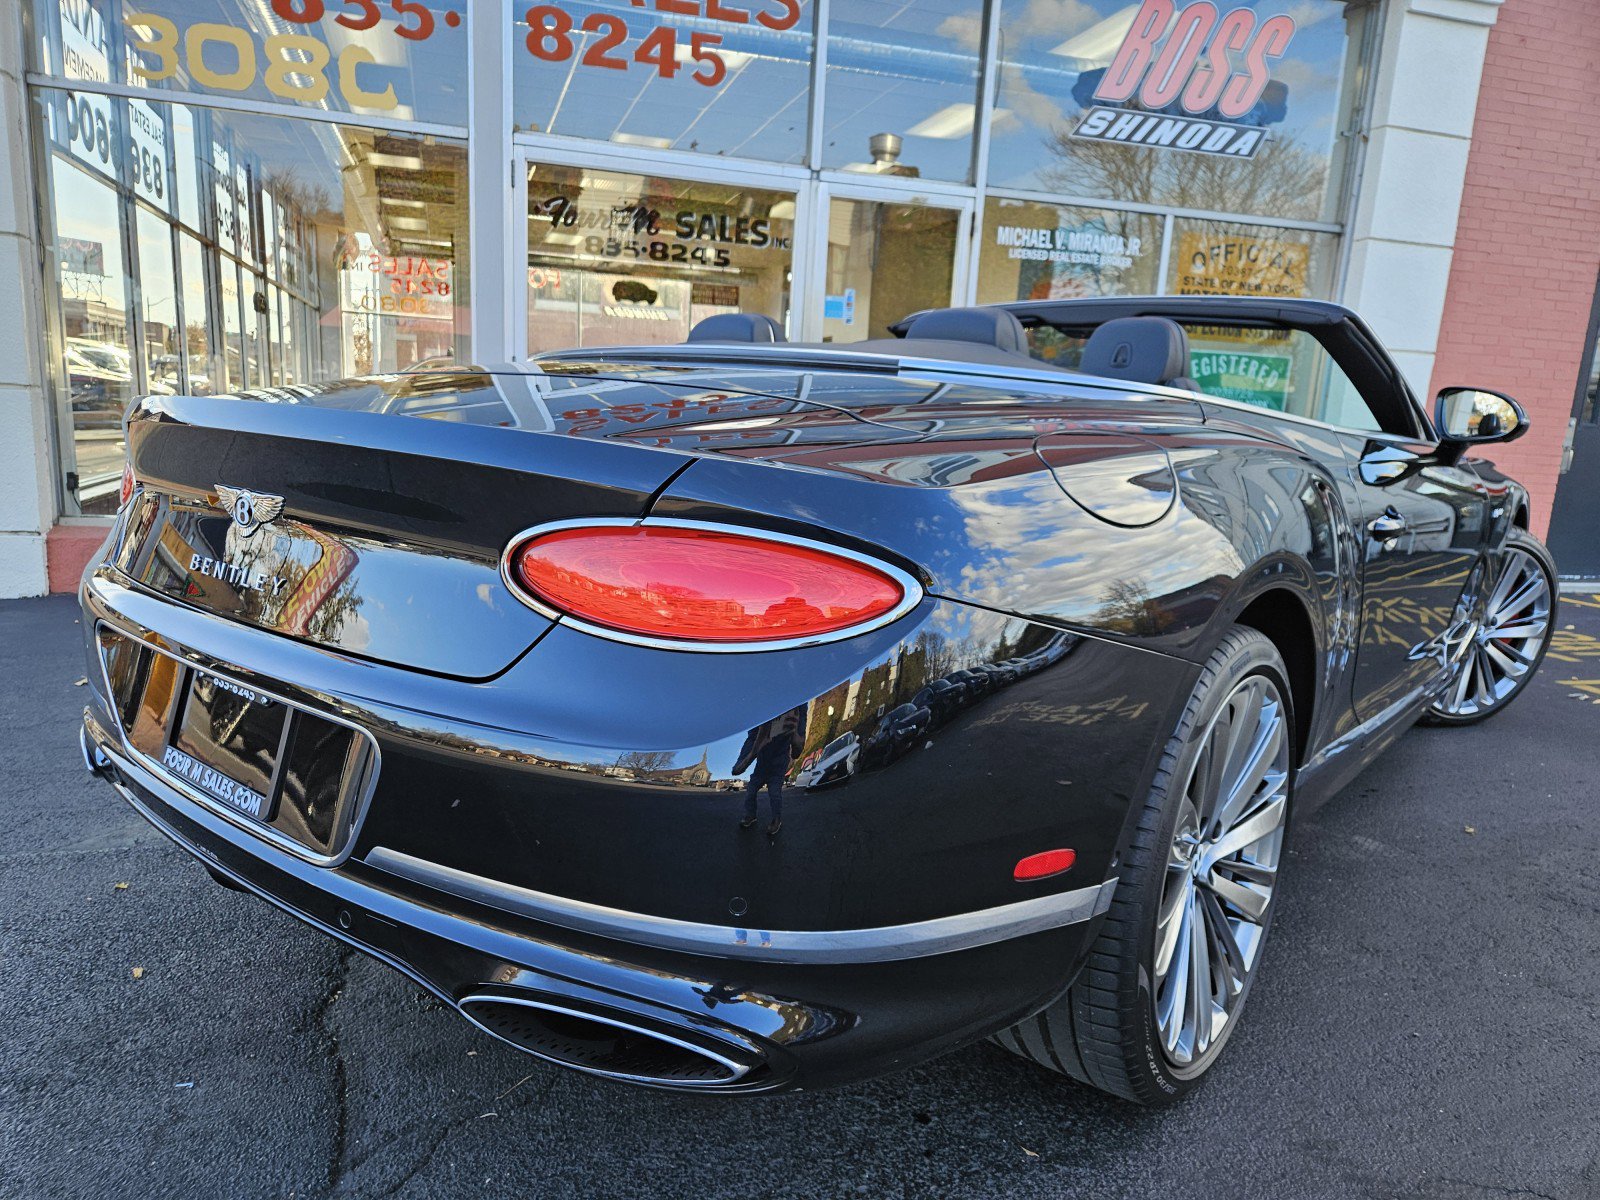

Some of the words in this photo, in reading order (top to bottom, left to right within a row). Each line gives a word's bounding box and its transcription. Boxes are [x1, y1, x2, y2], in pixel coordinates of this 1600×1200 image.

[526, 5, 727, 86] 8245
[1093, 0, 1296, 118] BOSS
[1077, 110, 1264, 157] SHINODA
[676, 211, 771, 250] SALES
[997, 226, 1053, 248] MICHAEL
[1068, 233, 1125, 255] MIRANDA
[1008, 248, 1048, 260] LICENSED
[1049, 251, 1070, 262] REAL
[1071, 253, 1100, 265] ESTATE
[1192, 243, 1295, 278] OFFICIAL
[1183, 276, 1216, 287] STATE
[1221, 279, 1234, 289] OF
[1239, 280, 1262, 291] NEW
[1268, 284, 1296, 294] YORK
[1191, 355, 1279, 388] EGISTERED
[189, 553, 288, 597] BENTLEY
[163, 747, 192, 776] FOUR
[190, 763, 203, 782] M
[202, 769, 262, 816] SALES.COM
